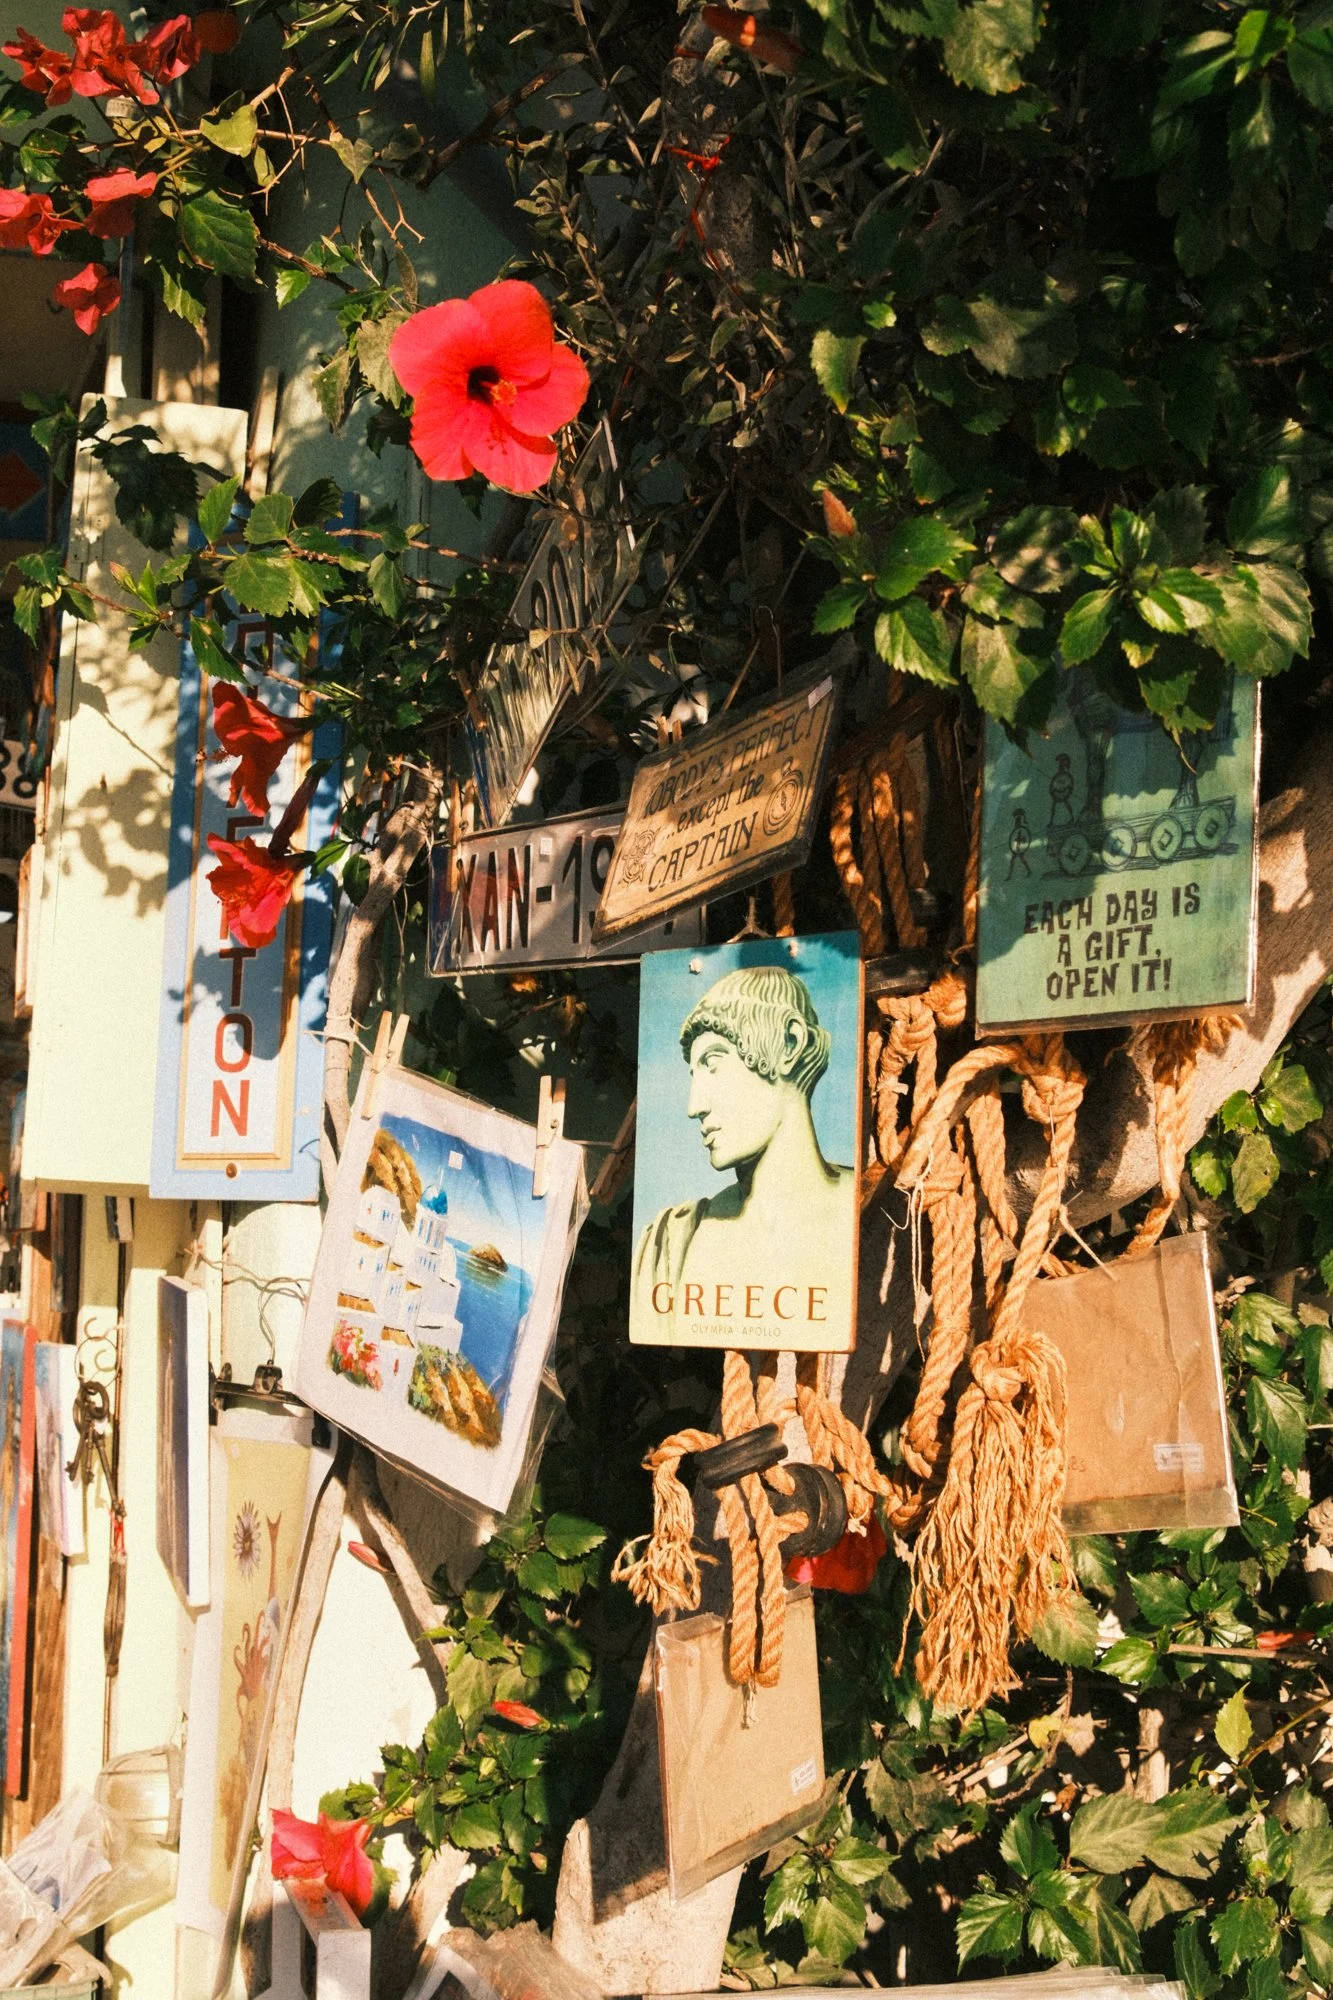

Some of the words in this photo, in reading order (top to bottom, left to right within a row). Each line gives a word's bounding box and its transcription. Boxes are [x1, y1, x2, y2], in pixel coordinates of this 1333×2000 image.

[727, 703, 821, 778] PERFECT
[736, 770, 765, 804] the
[648, 812, 758, 892] CAPTAIN
[1024, 896, 1092, 934] EACH
[1106, 888, 1157, 925] DAY
[1172, 882, 1200, 917] IS
[1057, 934, 1072, 967] A
[1085, 924, 1161, 961] GIFT,
[1046, 963, 1120, 1001] OPEN
[1131, 958, 1172, 993] IT!
[652, 1282, 828, 1321] GREECE
[691, 1323, 733, 1335] OLYMPIA
[742, 1326, 781, 1337] APOLLO
